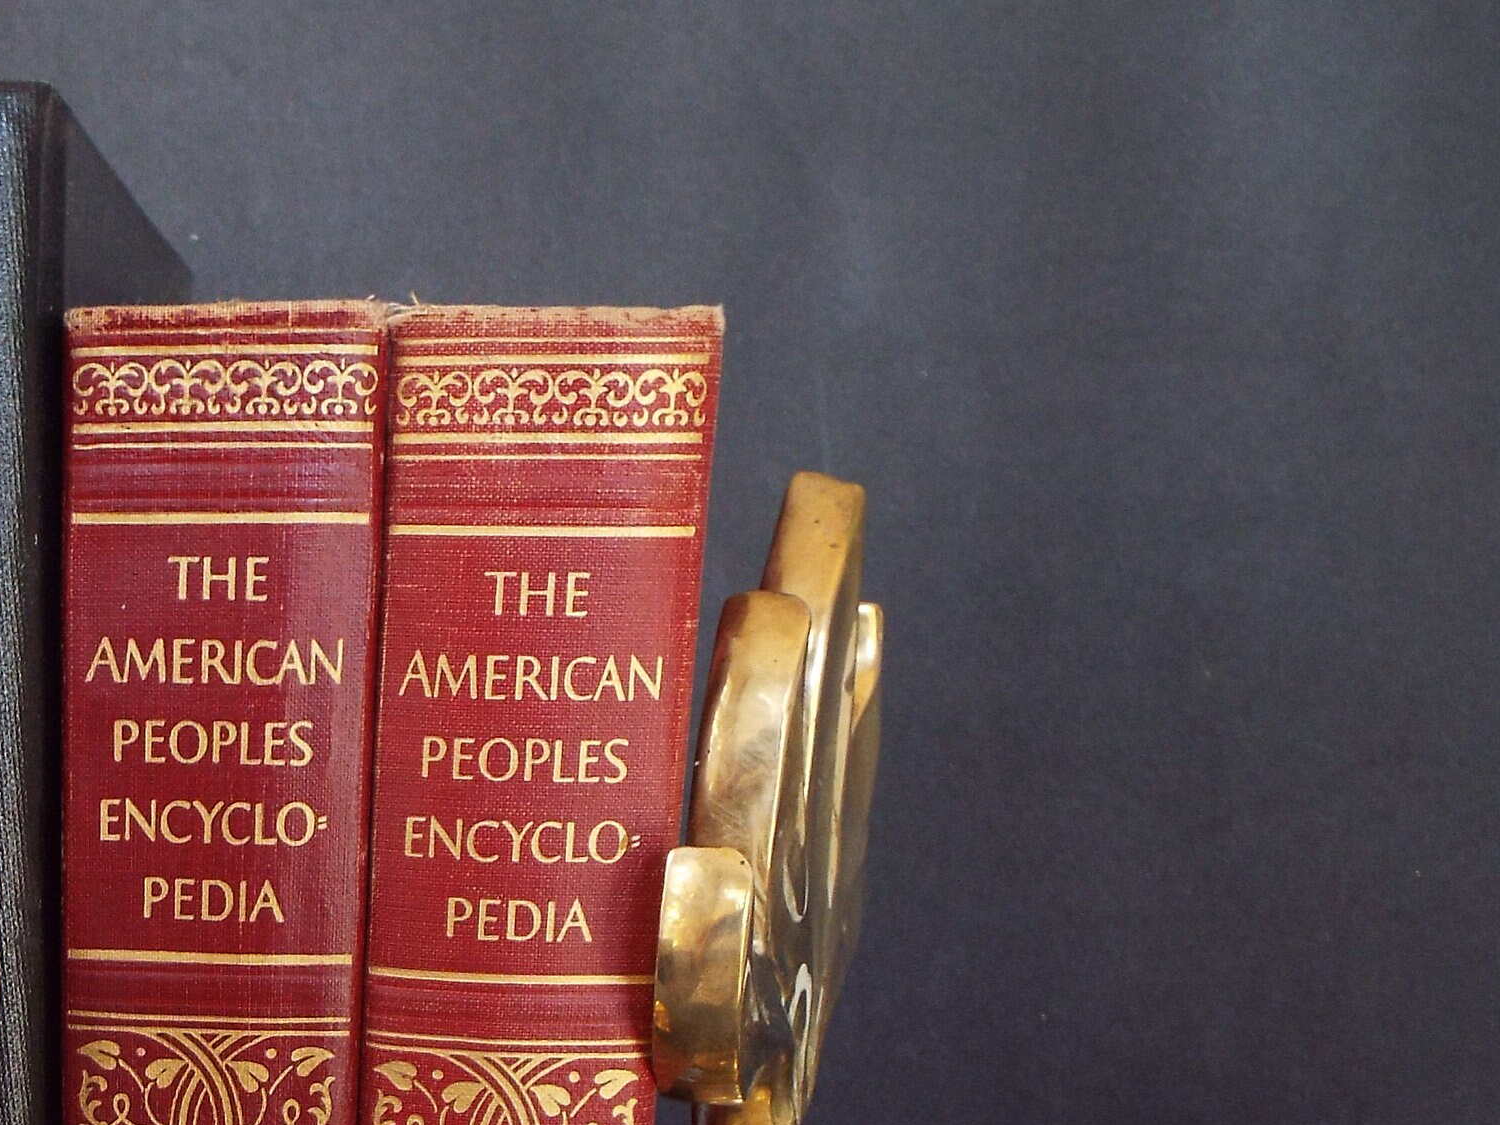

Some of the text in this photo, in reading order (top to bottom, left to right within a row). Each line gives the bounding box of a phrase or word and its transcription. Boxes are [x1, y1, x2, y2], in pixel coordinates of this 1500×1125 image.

[168, 557, 269, 601] THE
[484, 572, 591, 618] THE
[85, 637, 344, 685] AMERICAN
[399, 650, 663, 701] AMERICAN
[114, 720, 314, 767] PEOPLES
[422, 737, 629, 784] PEOPLES
[144, 877, 284, 923] PEDIA
[447, 896, 592, 942] PEDIA
